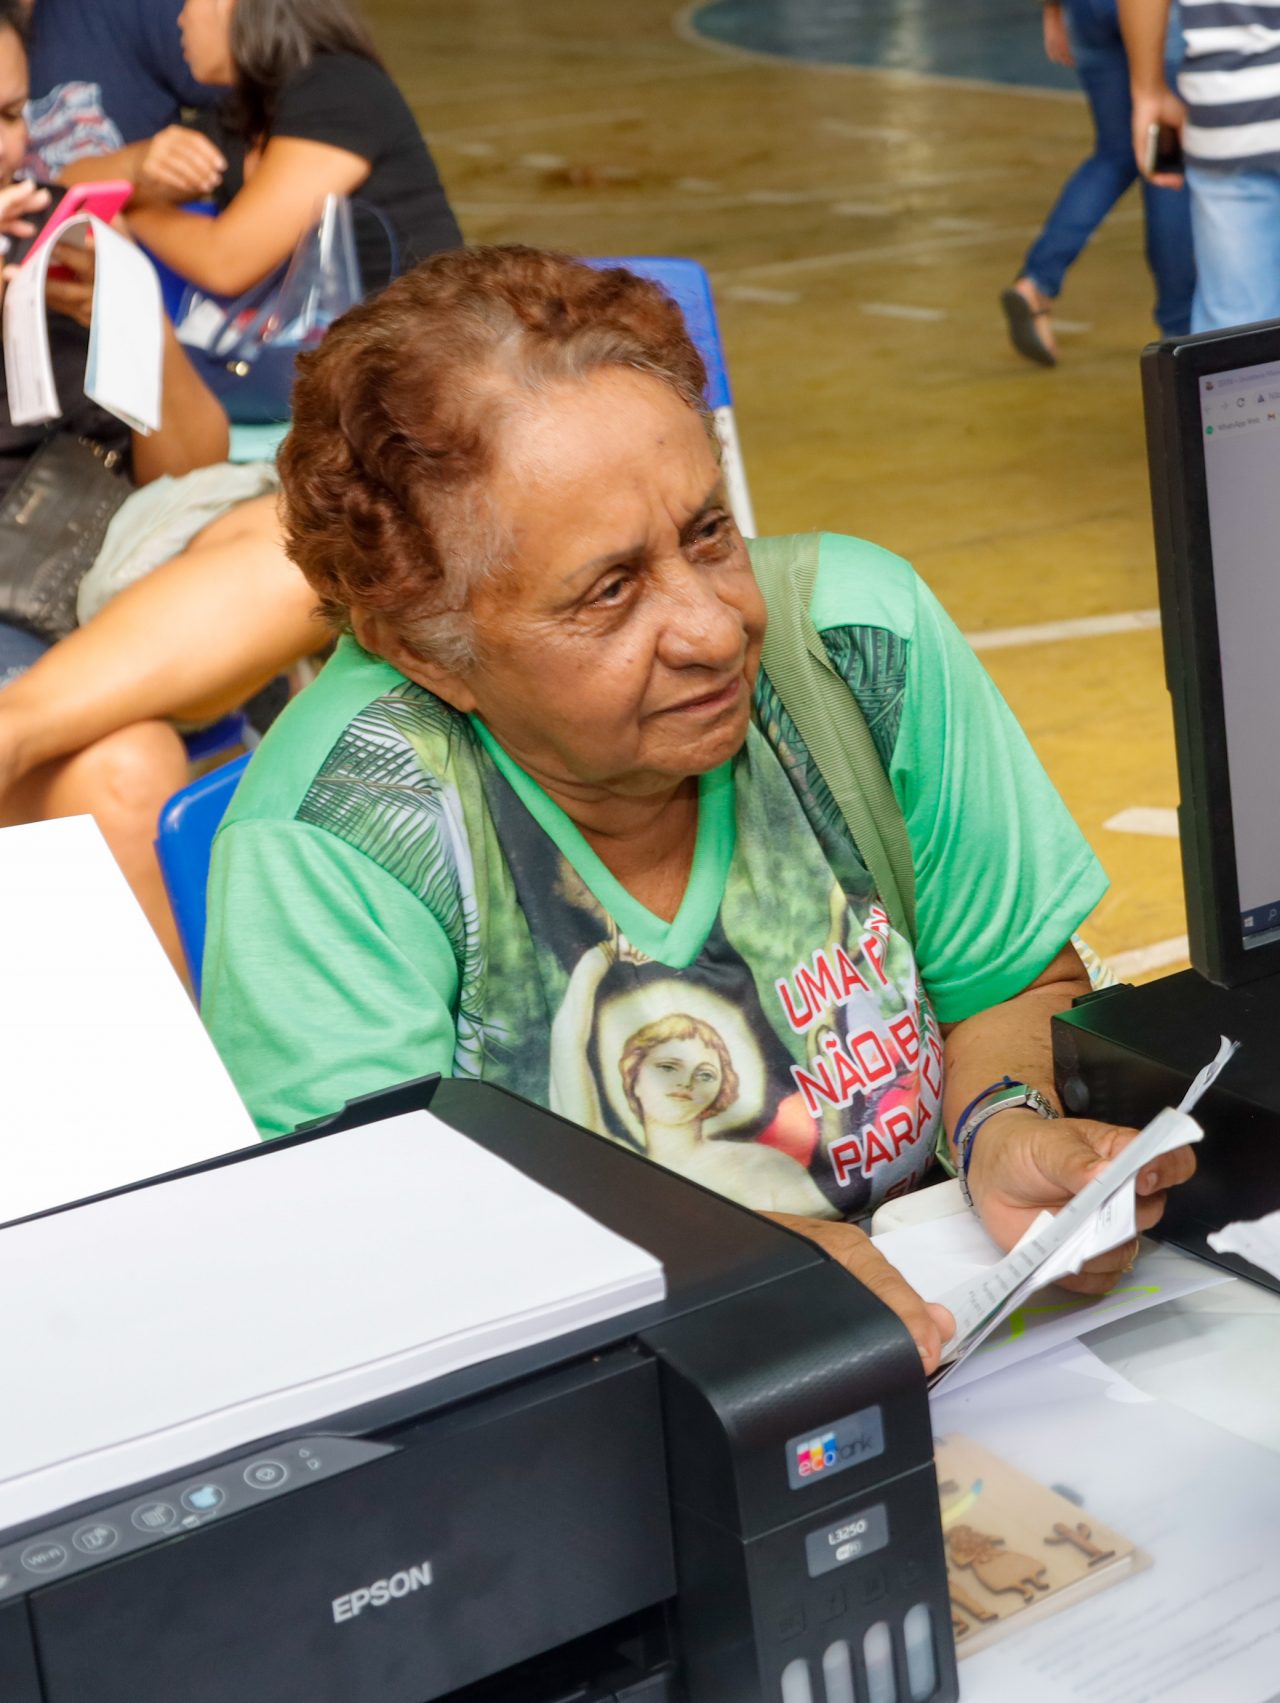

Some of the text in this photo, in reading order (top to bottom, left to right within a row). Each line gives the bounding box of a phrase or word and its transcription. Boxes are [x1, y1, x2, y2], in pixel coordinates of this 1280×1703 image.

[778, 948, 870, 1029] UMA
[794, 1030, 893, 1112] NÃO
[830, 1101, 932, 1181] PARA
[28, 1548, 61, 1566] Wi-Fi
[827, 1518, 867, 1545] L3250
[331, 1560, 434, 1624] EPSON
